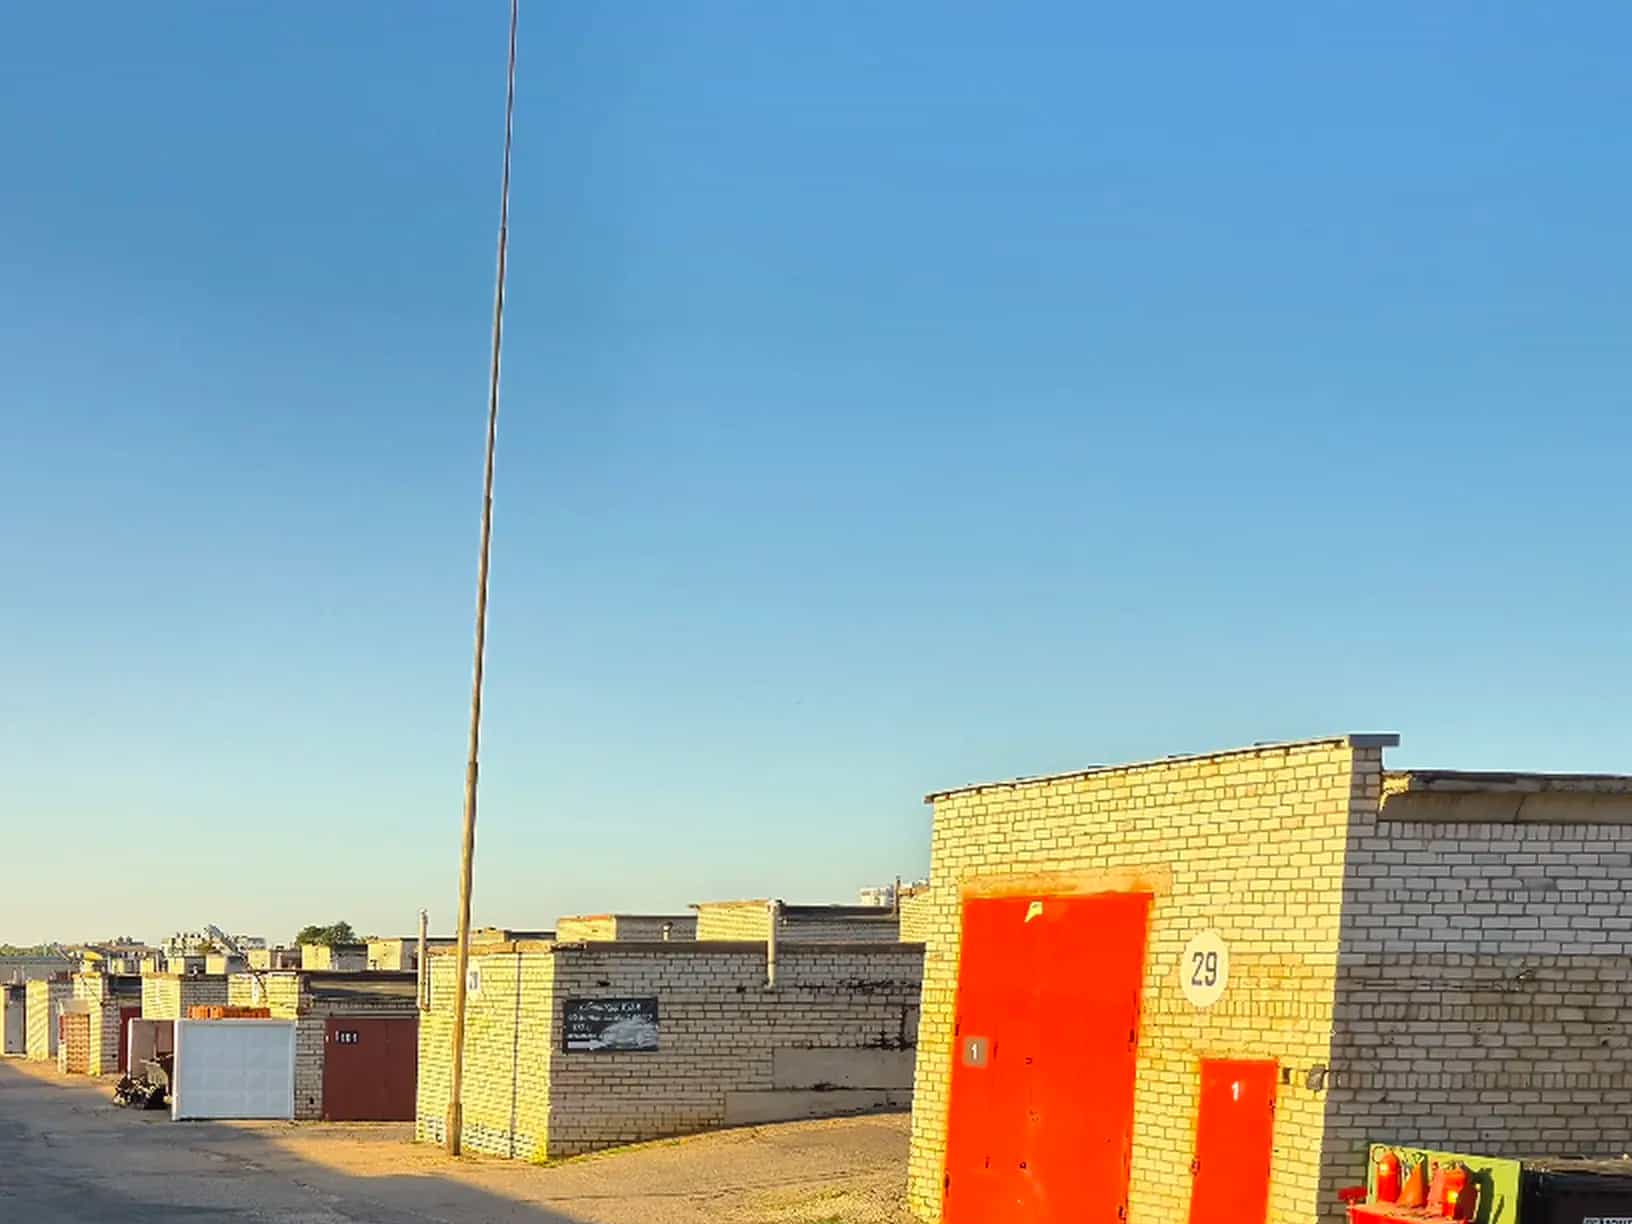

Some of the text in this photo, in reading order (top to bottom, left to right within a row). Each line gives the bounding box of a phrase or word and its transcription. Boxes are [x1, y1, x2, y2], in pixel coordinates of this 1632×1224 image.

[1191, 951, 1218, 987] 29
[971, 1043, 977, 1060] 1
[1231, 1080, 1240, 1103] 1
